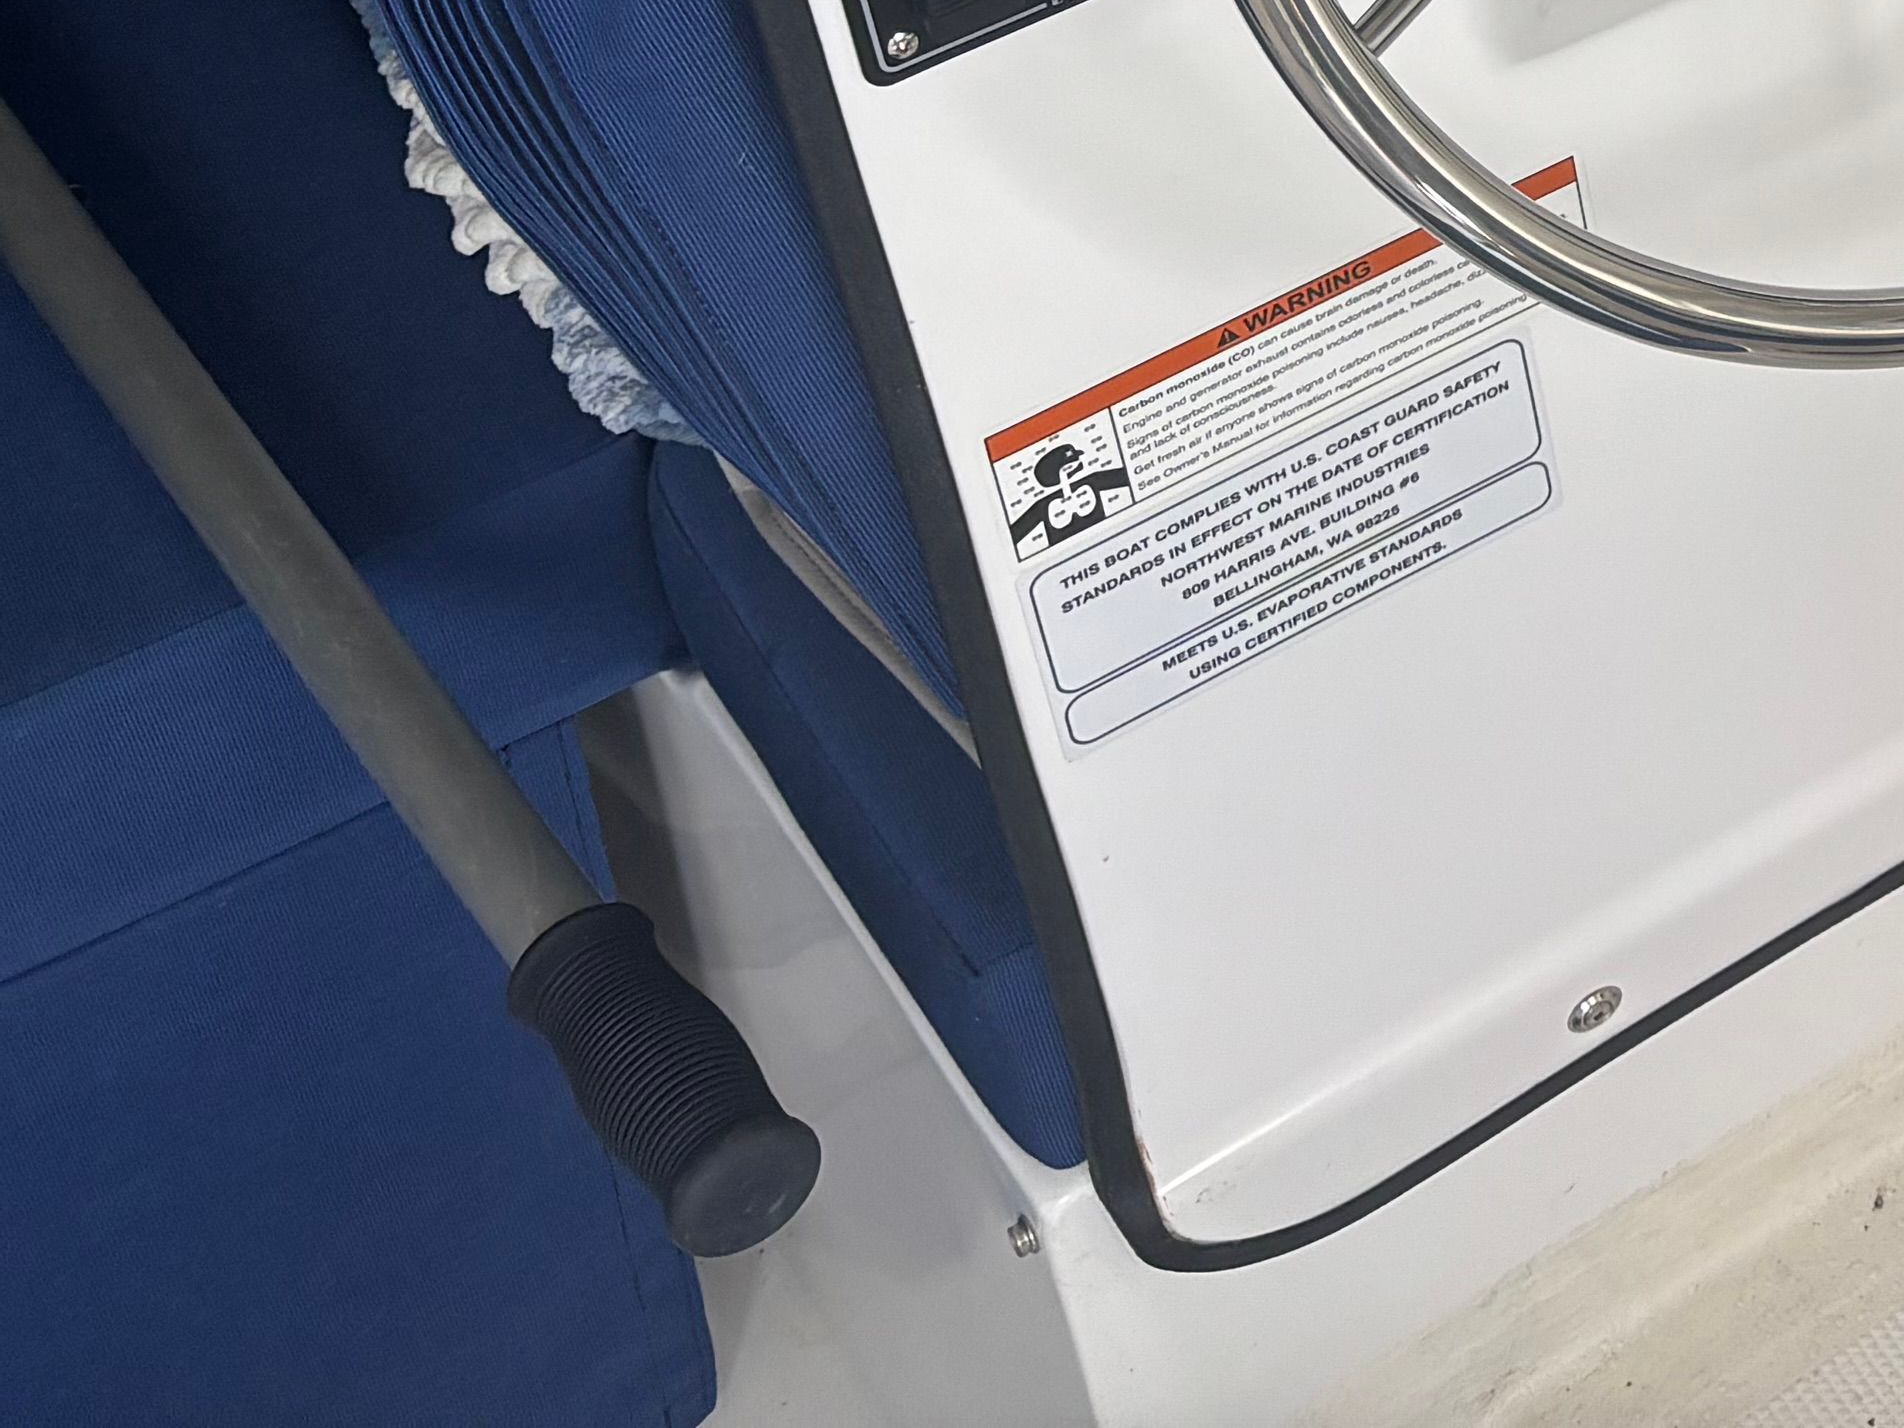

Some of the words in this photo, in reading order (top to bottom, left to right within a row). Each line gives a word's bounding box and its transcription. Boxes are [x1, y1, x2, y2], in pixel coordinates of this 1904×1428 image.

[1117, 391, 1164, 418] Carbon
[1165, 360, 1226, 395] monoxide
[1227, 344, 1255, 366] (CO)
[1279, 317, 1313, 339] cause
[1314, 303, 1343, 322] brain
[1344, 280, 1388, 307] damage
[1122, 408, 1163, 434] Engine
[1188, 368, 1243, 403] generator
[1244, 345, 1289, 373] exhaust
[1289, 323, 1336, 351] contains
[1337, 300, 1384, 328] odorless
[1407, 265, 1455, 294] colorless
[1243, 261, 1370, 331] WARNING
[1126, 428, 1159, 449] Signs
[1174, 401, 1214, 426] carbon
[1215, 373, 1270, 405] monoxide
[1271, 346, 1324, 379] poisoning
[1325, 327, 1364, 351] include
[1152, 431, 1178, 448] lack
[1156, 444, 1186, 464] fresh
[1214, 409, 1256, 435] anyone
[1257, 391, 1294, 414] shows
[1294, 375, 1325, 396] signs
[1338, 349, 1376, 373] carbon
[1377, 323, 1430, 354] monoxide
[1211, 426, 1253, 454] Manual
[1271, 388, 1333, 424] information
[1334, 362, 1385, 393] regarding
[1386, 343, 1424, 367] carbon
[1424, 317, 1476, 347] monoxide
[1058, 562, 1100, 589] THIS
[1103, 535, 1150, 568] BOAT
[1154, 490, 1241, 542] COMPLIES
[1243, 467, 1287, 496] WITH
[1289, 452, 1322, 474] U.S.
[1324, 420, 1380, 456] COAST
[1383, 392, 1440, 427] GUARD
[1442, 360, 1501, 398] SAFETY
[1060, 552, 1165, 614] STANDARDS
[1167, 541, 1187, 559] IN
[1189, 506, 1253, 548] EFFECT
[1256, 492, 1282, 514] ON
[1283, 475, 1319, 499] THE
[1320, 452, 1364, 482] DATE
[1366, 439, 1389, 458] OF
[1391, 379, 1509, 446] CERTIFICATION
[1159, 524, 1265, 587] NORTHWEST
[1268, 491, 1332, 532] MARINE
[1335, 442, 1430, 498] INDUSTRIES
[1181, 577, 1210, 600] 809
[1213, 543, 1276, 584] HARRIS
[1279, 525, 1316, 551] AVE.
[1318, 483, 1395, 530] BUILDING
[1398, 471, 1420, 489] #6
[1161, 634, 1218, 671] MEETS
[1220, 618, 1253, 640] U.S.
[1256, 557, 1366, 622] EVAPORATIVE
[1368, 507, 1463, 564] STANDARDS
[1188, 645, 1241, 679] USING
[1244, 599, 1328, 650] CERTIFIED
[1331, 540, 1447, 605] COMPONENTS.
[1212, 544, 1324, 608] BELLINGHAM,
[1325, 528, 1353, 548] WA
[1354, 503, 1400, 534] 98225
